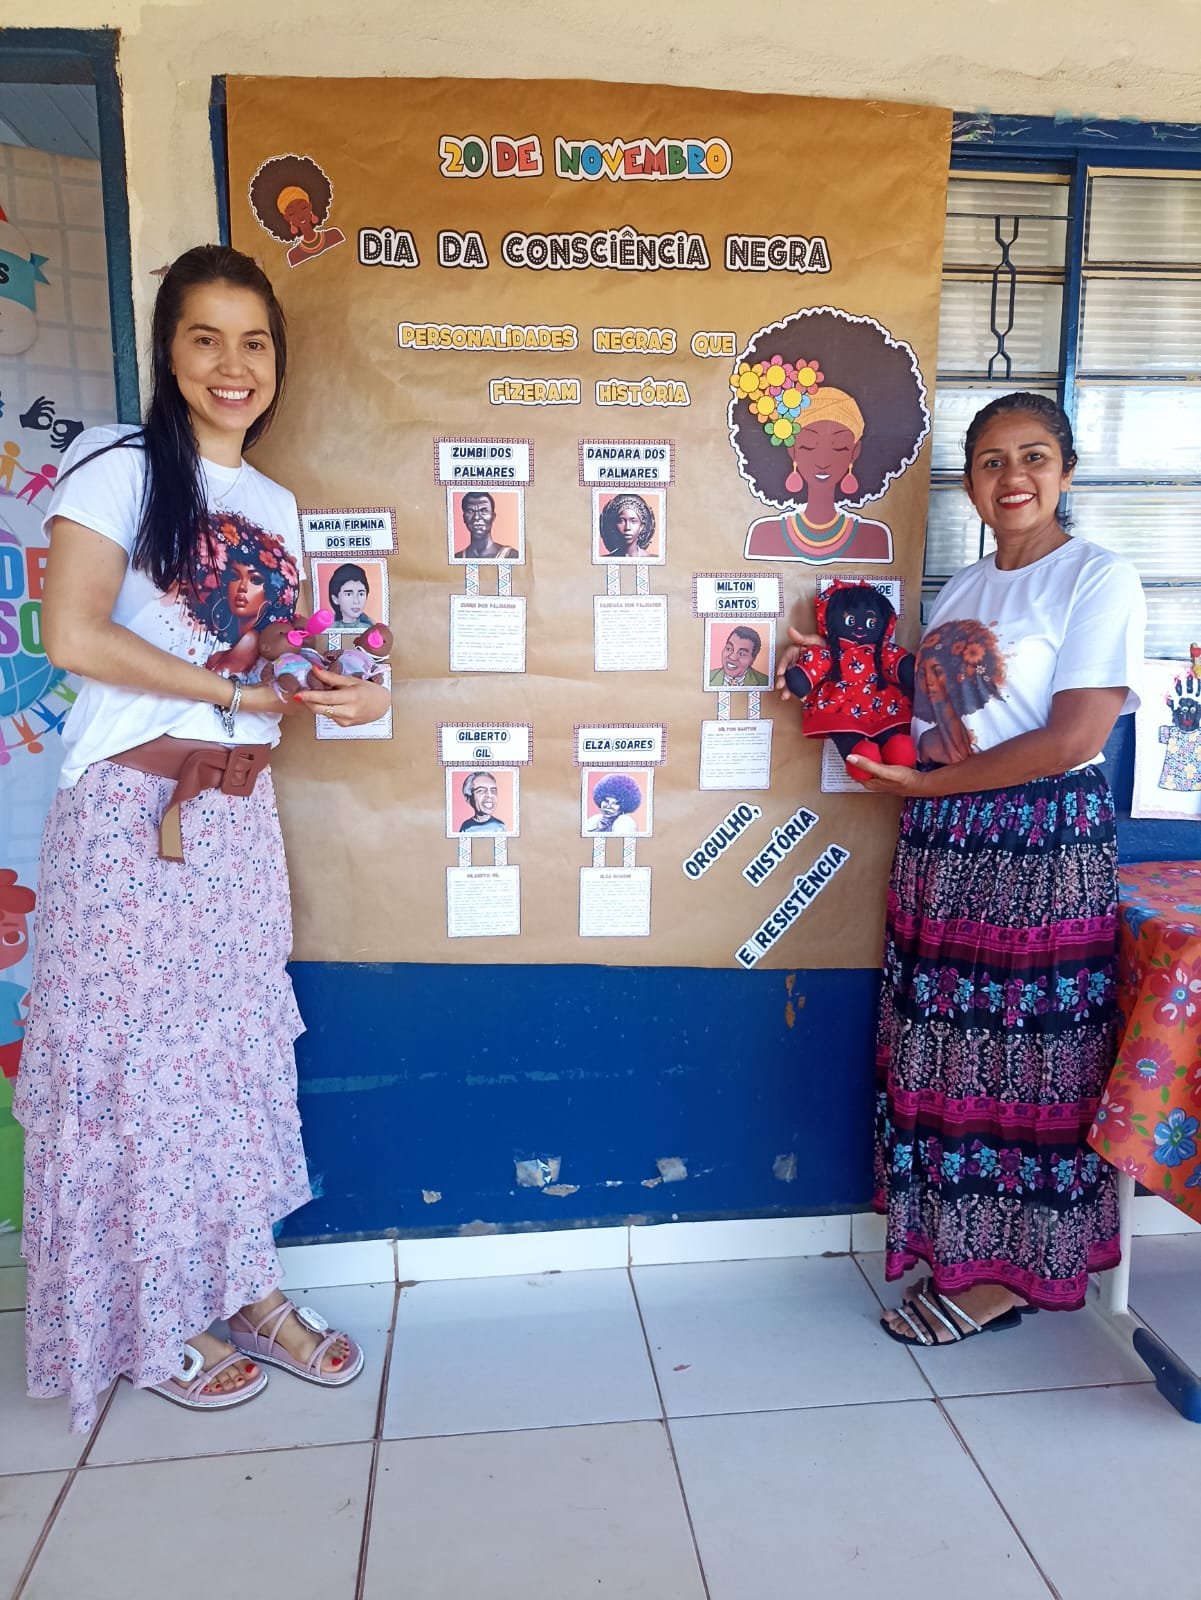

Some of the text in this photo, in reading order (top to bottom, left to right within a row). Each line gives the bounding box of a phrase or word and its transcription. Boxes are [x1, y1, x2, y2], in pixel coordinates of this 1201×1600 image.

[442, 139, 729, 177] 20 DE NOVEMBRO
[362, 230, 828, 269] DIA DA CONSCIÊNCIA NEGRA
[400, 325, 734, 354] PERSONALIDADES NEGRAS QUE
[491, 379, 688, 404] FIZERAM HISTÓRIA
[452, 446, 513, 460] ZUMBI DOS
[586, 447, 666, 461] DANDARA DOS
[453, 465, 516, 479] PALMARES
[598, 466, 660, 480] PALMARES
[308, 517, 386, 532] MARIA FIRMINA
[325, 535, 372, 549] DOS REIS
[715, 580, 755, 593] MILTON
[716, 598, 759, 611] SANTOS
[457, 730, 509, 743] GILBERTO
[584, 738, 654, 751] ELZA SOARES
[474, 748, 492, 759] GIL
[684, 804, 761, 877] ORGULHO,
[745, 809, 817, 884] HISTÓRIA
[737, 947, 756, 966] E
[754, 846, 848, 949] RESISTÊNCIA
